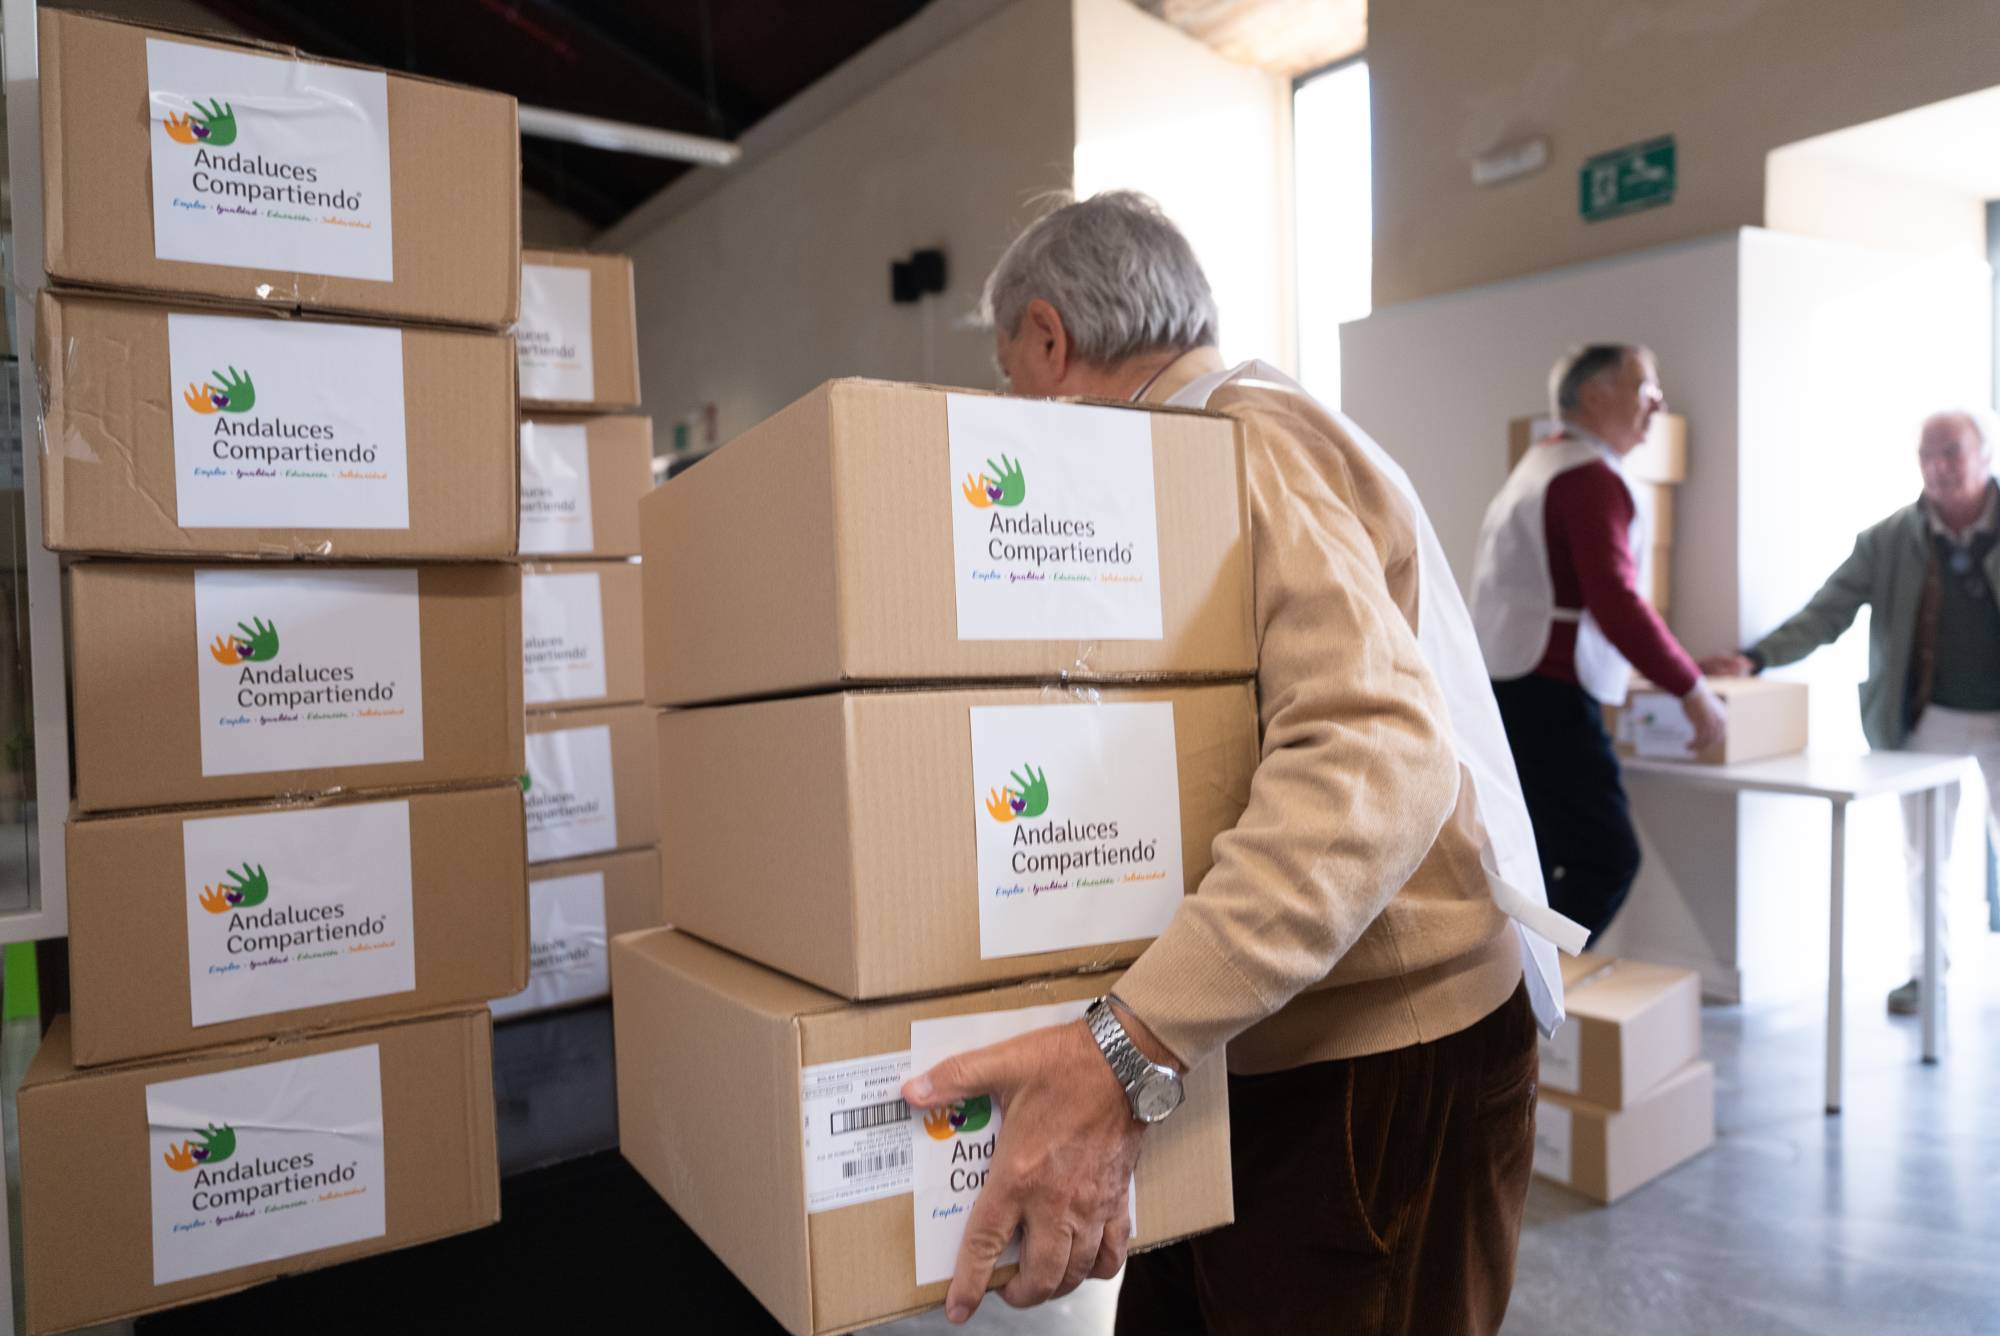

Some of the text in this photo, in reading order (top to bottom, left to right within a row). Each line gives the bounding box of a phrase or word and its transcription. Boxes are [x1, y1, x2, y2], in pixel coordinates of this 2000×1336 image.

[194, 148, 317, 183] Andaluces
[213, 416, 334, 439] Andaluces
[989, 511, 1095, 537] Andaluces
[238, 663, 354, 685] Andaluces
[1012, 818, 1119, 847] Andaluces
[228, 902, 345, 932] Andaluces
[952, 1132, 996, 1164] And
[193, 1152, 314, 1190] Andaluces
